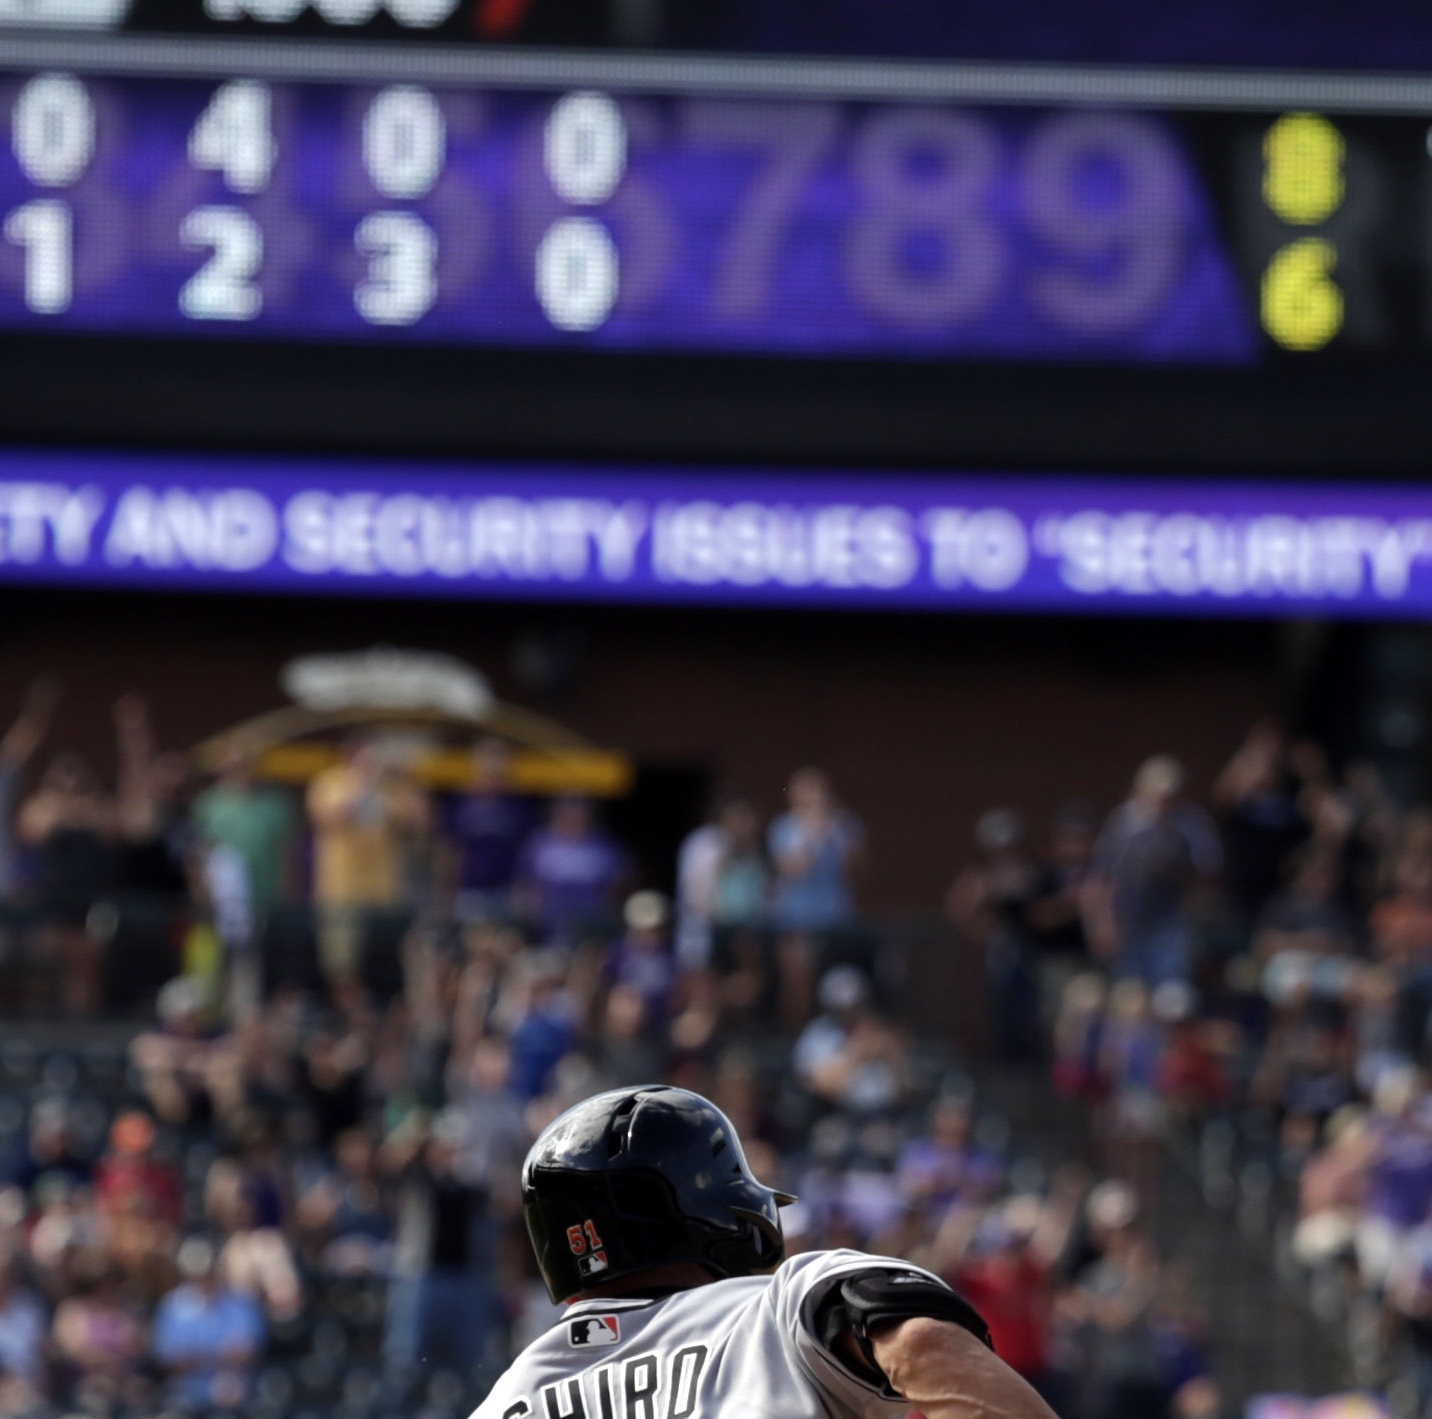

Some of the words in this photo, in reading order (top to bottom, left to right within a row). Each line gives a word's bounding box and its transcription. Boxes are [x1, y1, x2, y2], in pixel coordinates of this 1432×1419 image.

[12, 75, 95, 186] 0
[188, 82, 278, 193] 4
[362, 87, 445, 200] 0
[543, 93, 627, 205] 0
[1263, 115, 1344, 225] 8
[4, 199, 74, 314] 1
[179, 205, 264, 321] 2
[355, 211, 439, 326] 3
[535, 217, 619, 332] 0
[1262, 240, 1343, 349] 6
[104, 485, 278, 572] AND
[282, 488, 647, 583] SECURITY
[651, 500, 920, 589] ISSUES
[920, 506, 1030, 592] TO
[566, 1219, 603, 1255] 51
